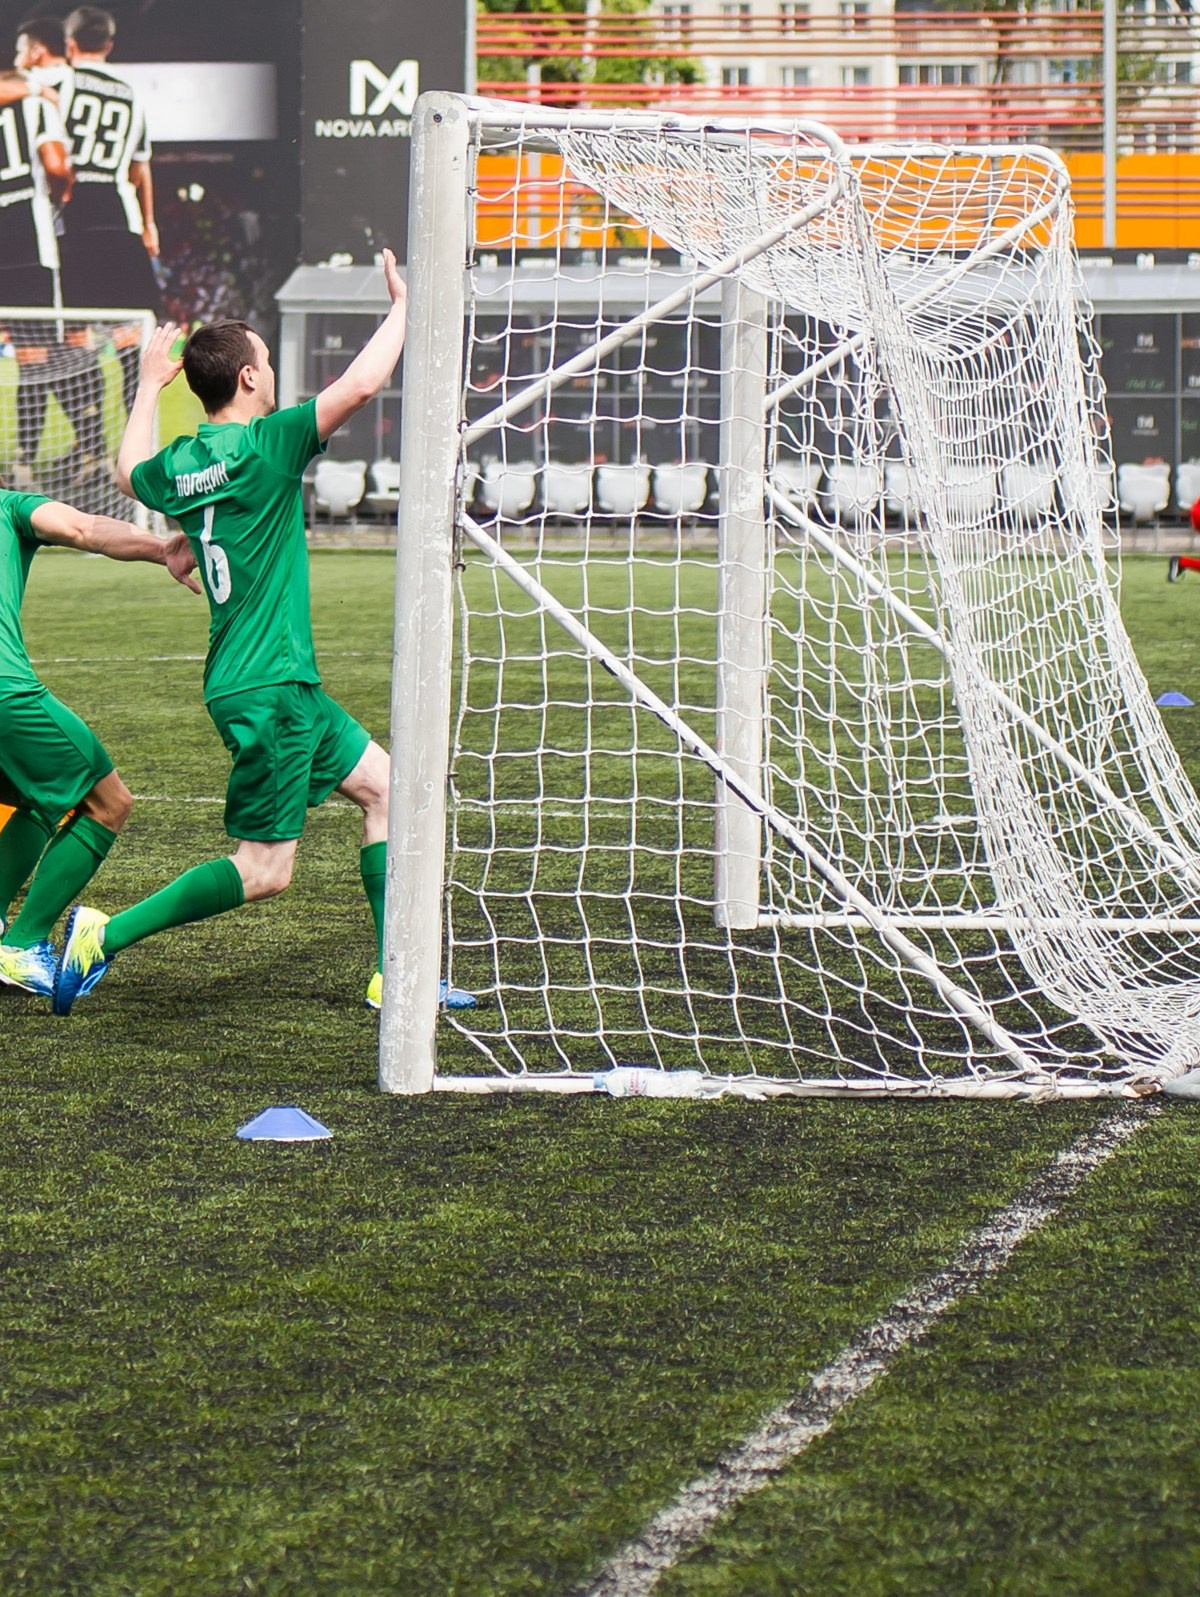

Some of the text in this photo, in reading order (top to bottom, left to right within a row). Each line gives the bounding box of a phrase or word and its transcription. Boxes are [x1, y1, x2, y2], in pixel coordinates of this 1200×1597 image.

[72, 94, 130, 169] 33
[315, 119, 412, 138] NOVA AR
[200, 504, 232, 605] 6
